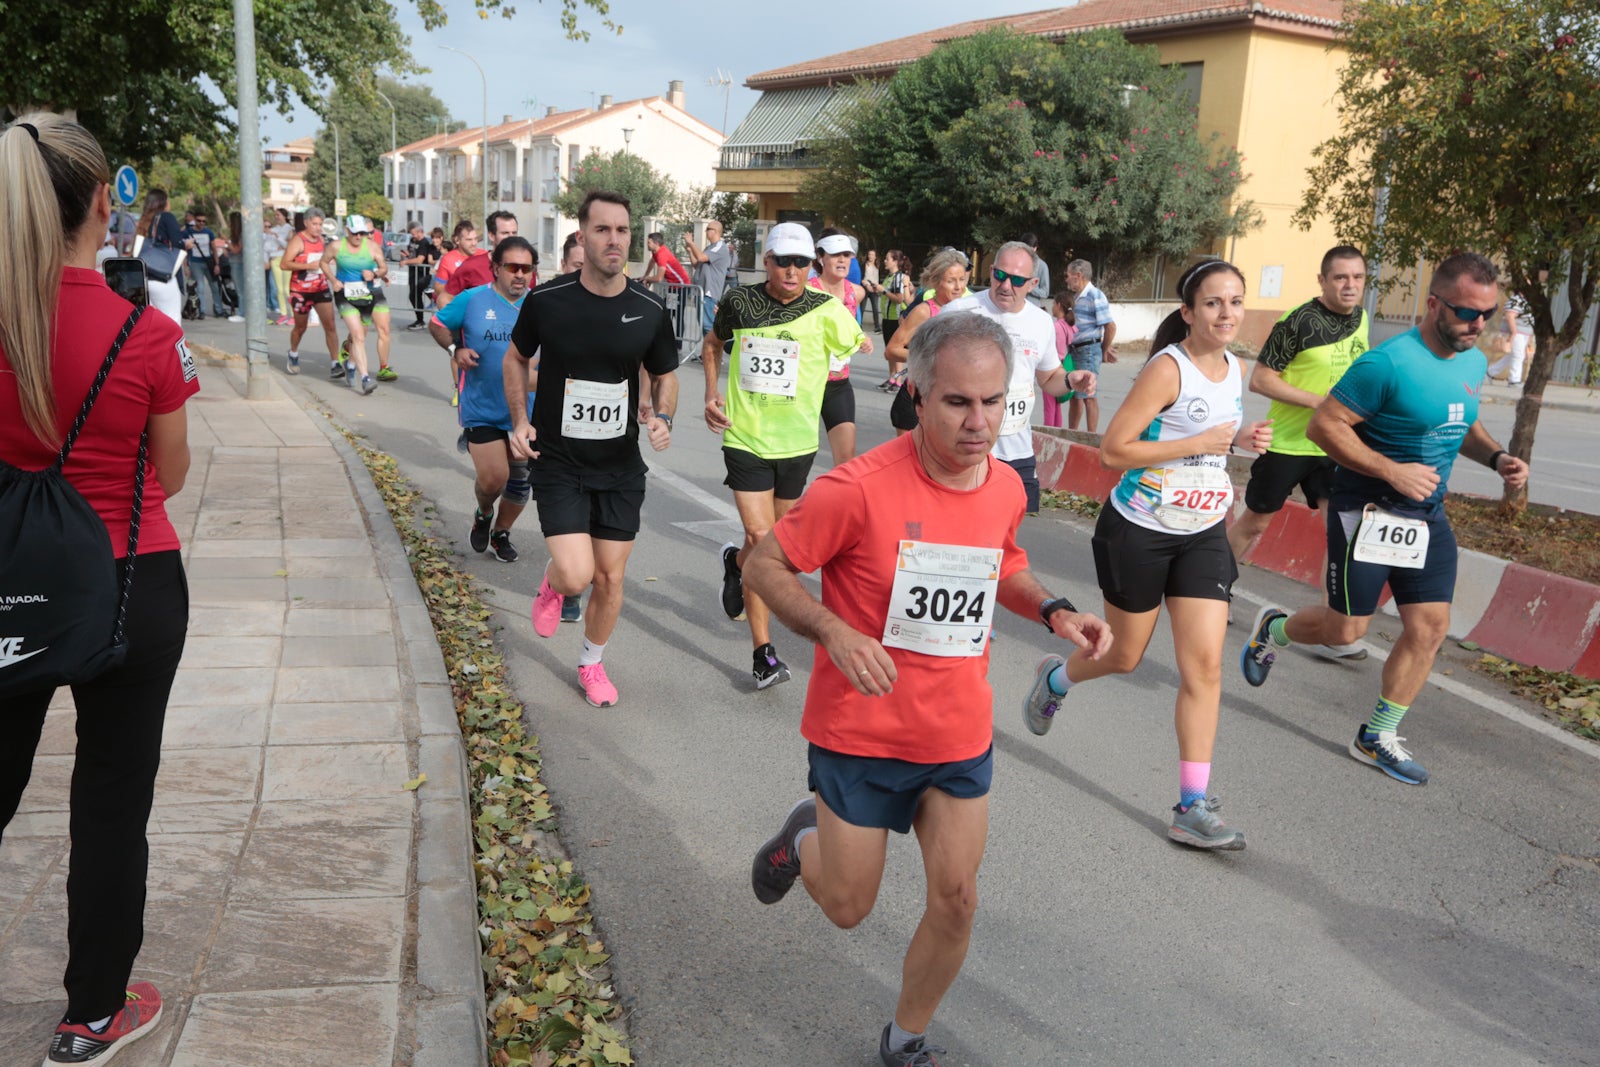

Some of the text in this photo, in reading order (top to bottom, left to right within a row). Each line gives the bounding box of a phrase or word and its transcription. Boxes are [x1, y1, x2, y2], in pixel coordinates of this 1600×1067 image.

[750, 356, 785, 376] 333
[571, 403, 621, 423] 3101
[1171, 489, 1228, 511] 2027
[1377, 524, 1418, 546] 160
[5, 595, 49, 604] NADAL
[905, 585, 986, 624] 3024
[0, 637, 25, 657] KE
